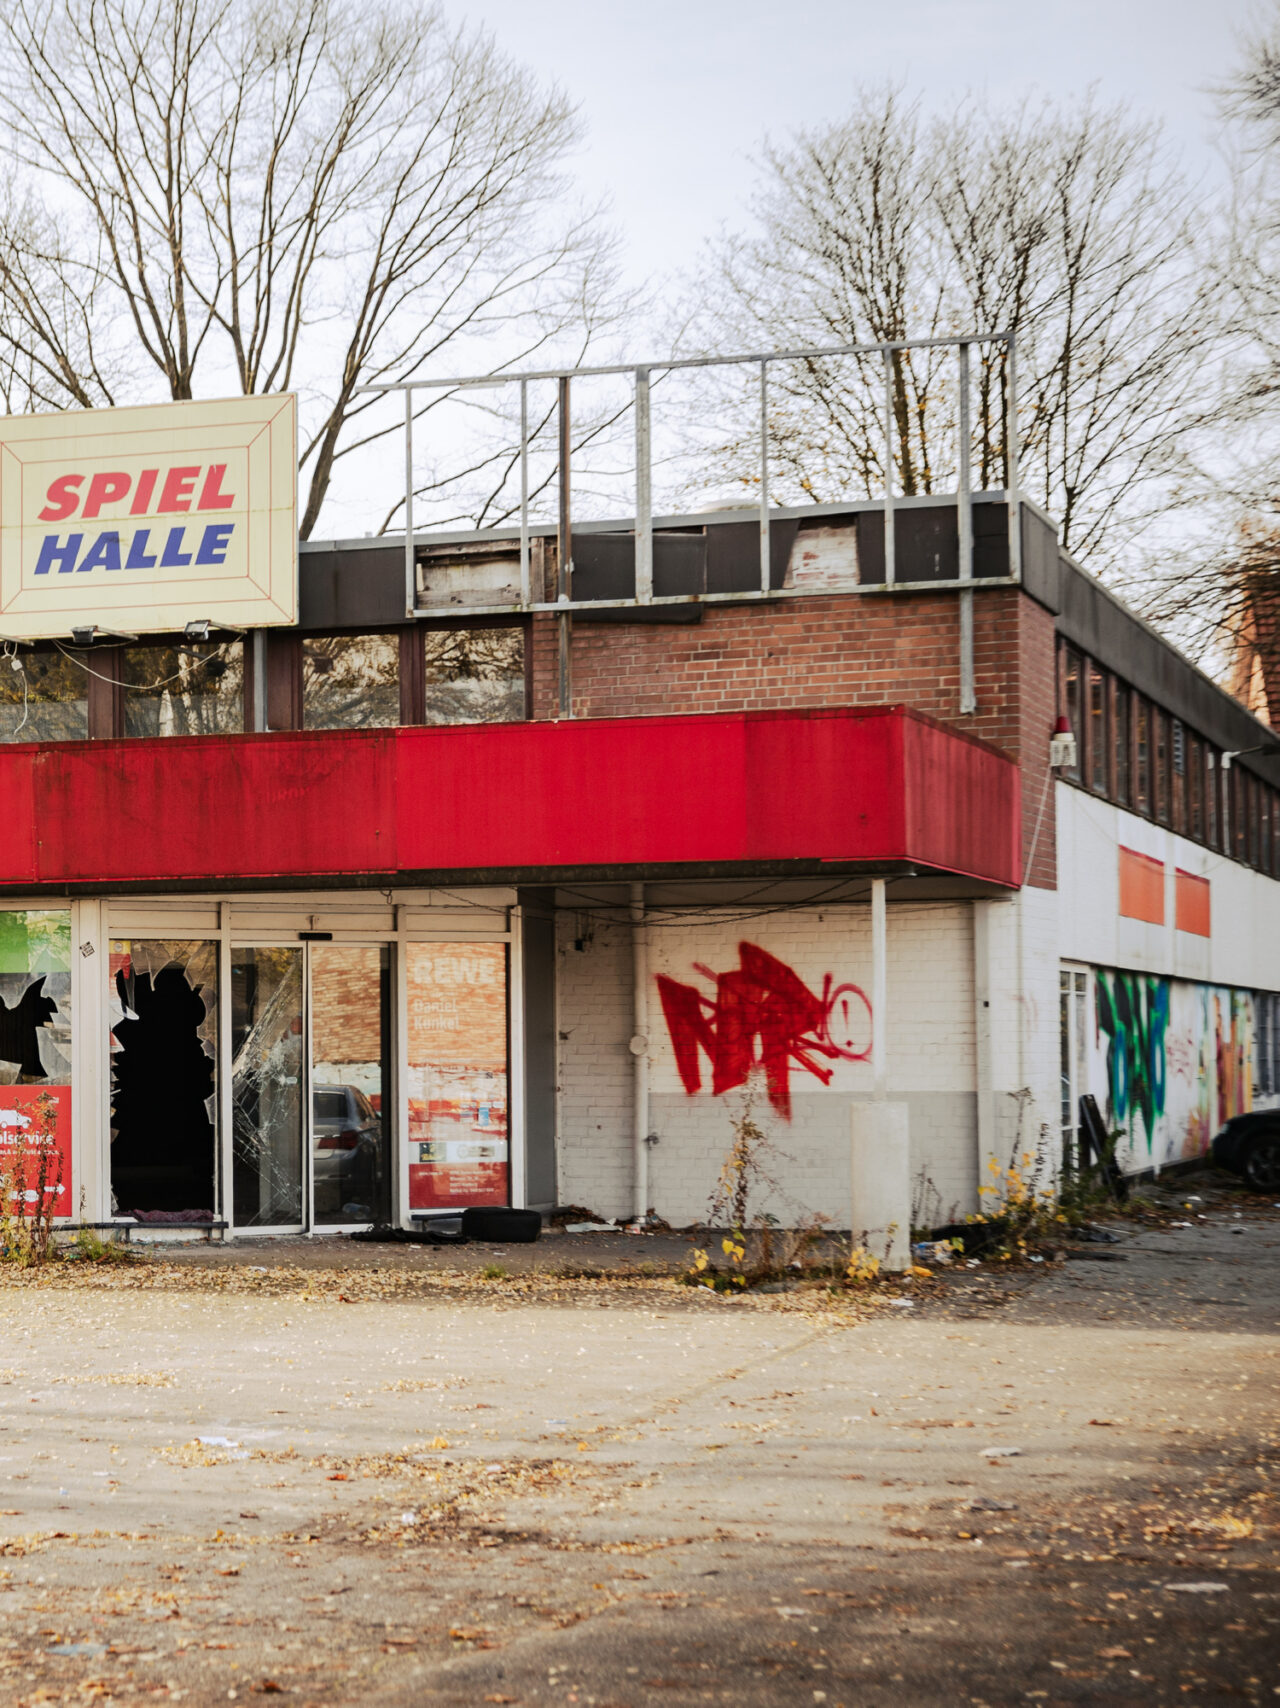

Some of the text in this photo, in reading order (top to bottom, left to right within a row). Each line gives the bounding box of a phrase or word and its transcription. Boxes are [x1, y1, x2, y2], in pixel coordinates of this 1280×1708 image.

[37, 463, 236, 522] SPIEL
[33, 523, 236, 576] HALLE
[414, 957, 497, 985] REWE
